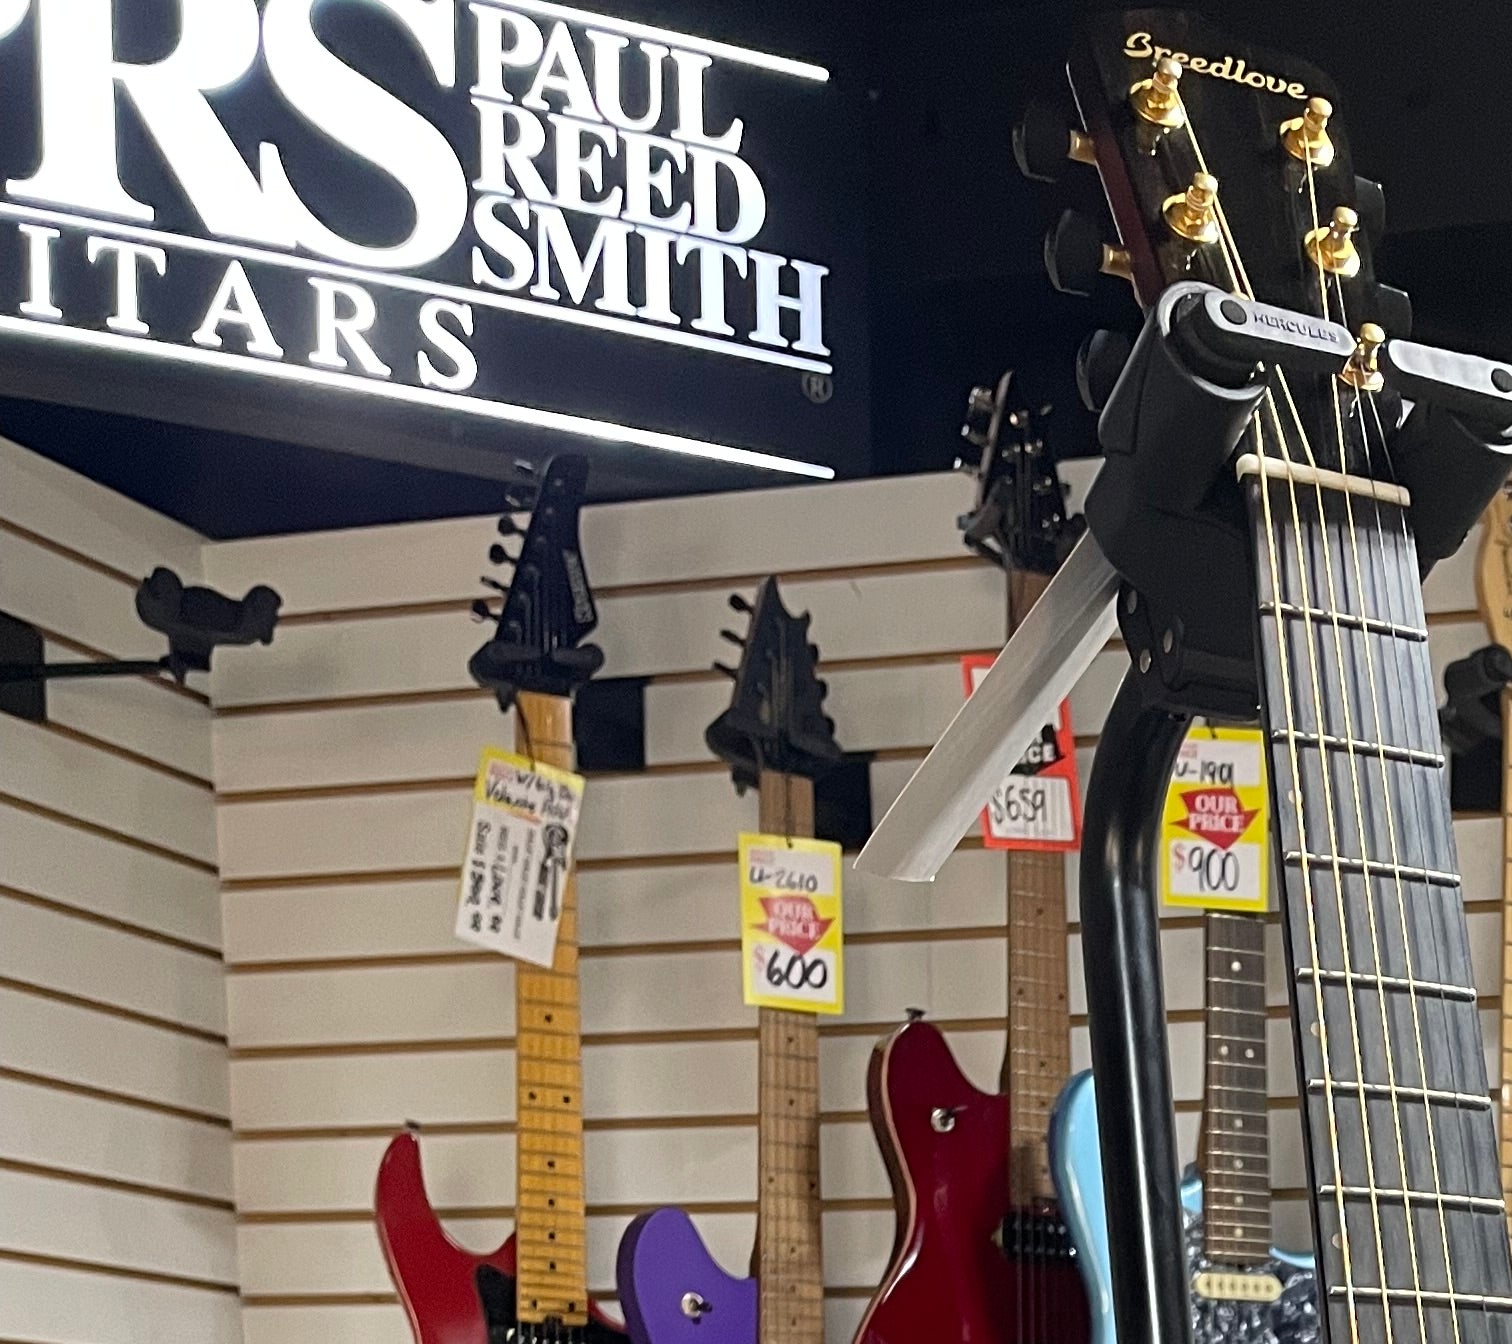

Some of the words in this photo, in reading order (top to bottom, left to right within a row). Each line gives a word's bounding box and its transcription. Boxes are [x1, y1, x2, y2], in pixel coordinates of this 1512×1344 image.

[469, 3, 744, 154] PAUL
[1123, 31, 1309, 101] Breedlove
[0, 0, 469, 269] RS
[470, 94, 768, 246] REED
[471, 193, 832, 356] SMITH
[1252, 311, 1339, 344] HERCULES
[1188, 812, 1246, 833] PRICE
[1194, 794, 1239, 814] OUR
[1173, 844, 1241, 892] $900
[767, 916, 822, 941] PRICE
[771, 901, 815, 922] OUR
[753, 944, 828, 990] $600
